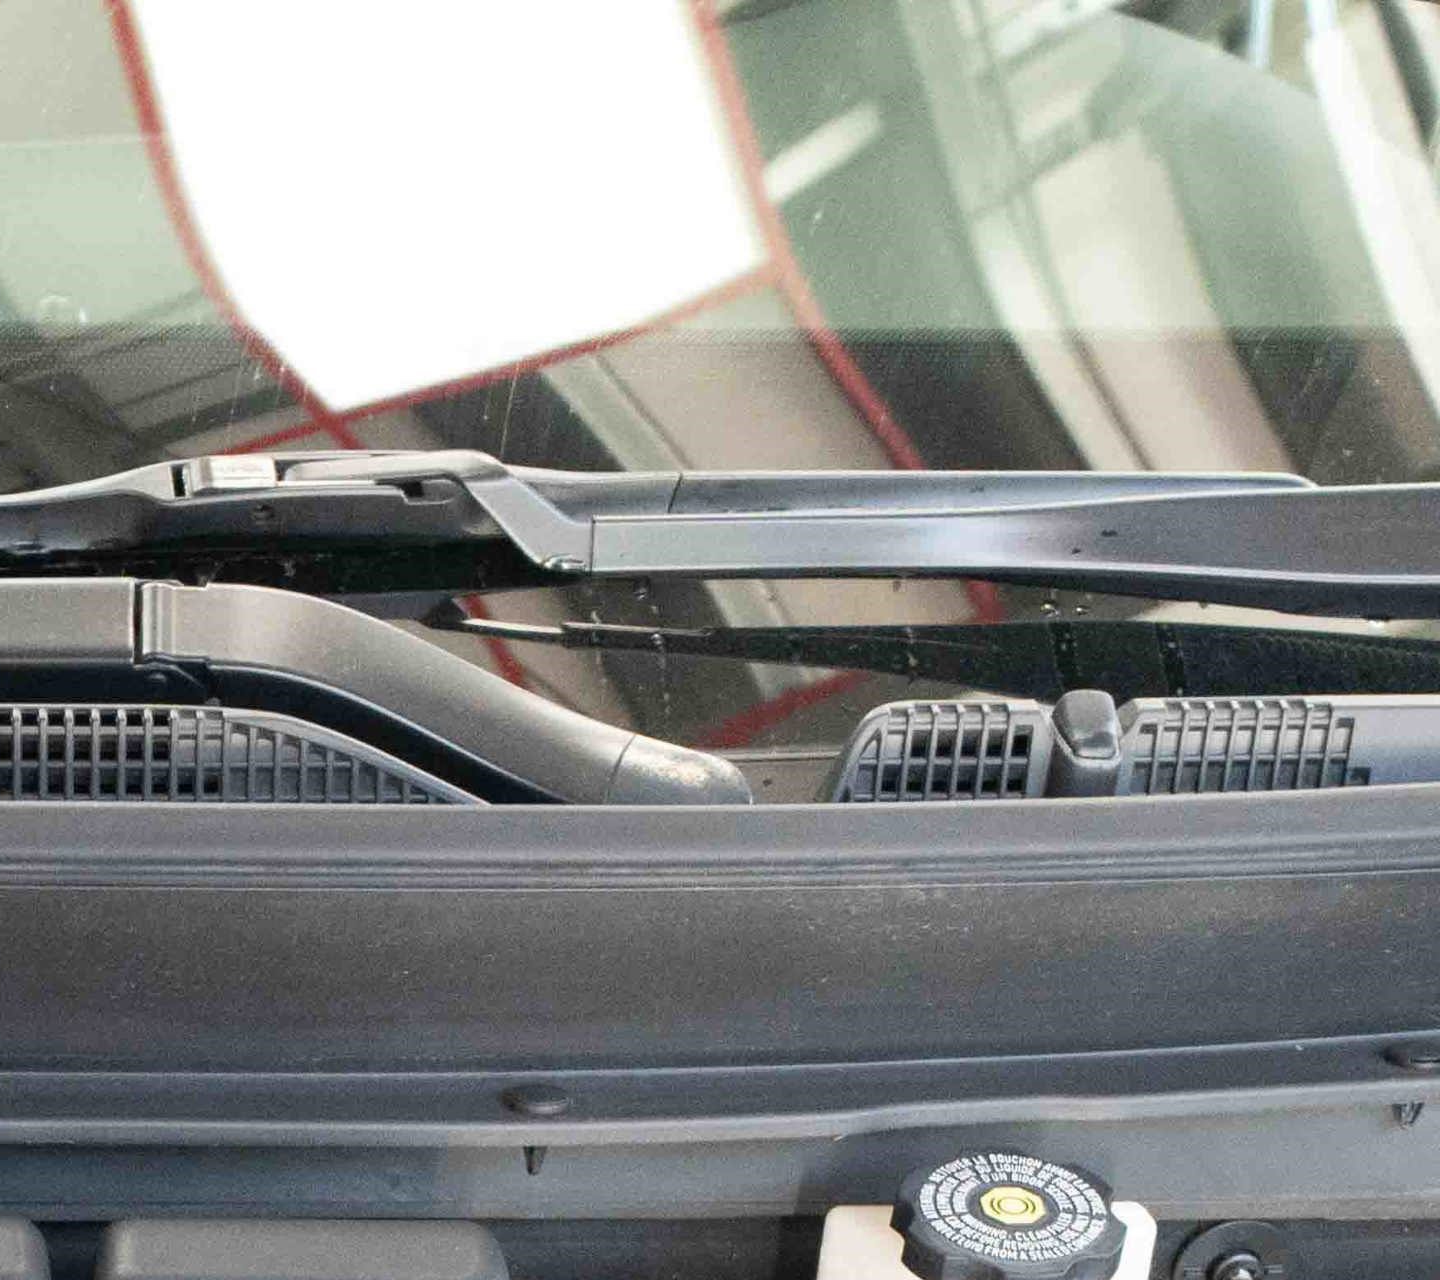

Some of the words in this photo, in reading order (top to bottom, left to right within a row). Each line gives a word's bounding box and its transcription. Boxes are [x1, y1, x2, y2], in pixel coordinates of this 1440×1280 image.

[988, 1153, 1043, 1169] BOUCHON
[993, 1163, 1036, 1175] LIQUIDE
[1011, 1172, 1045, 1189] BIDON
[984, 1246, 1017, 1260] FROM
